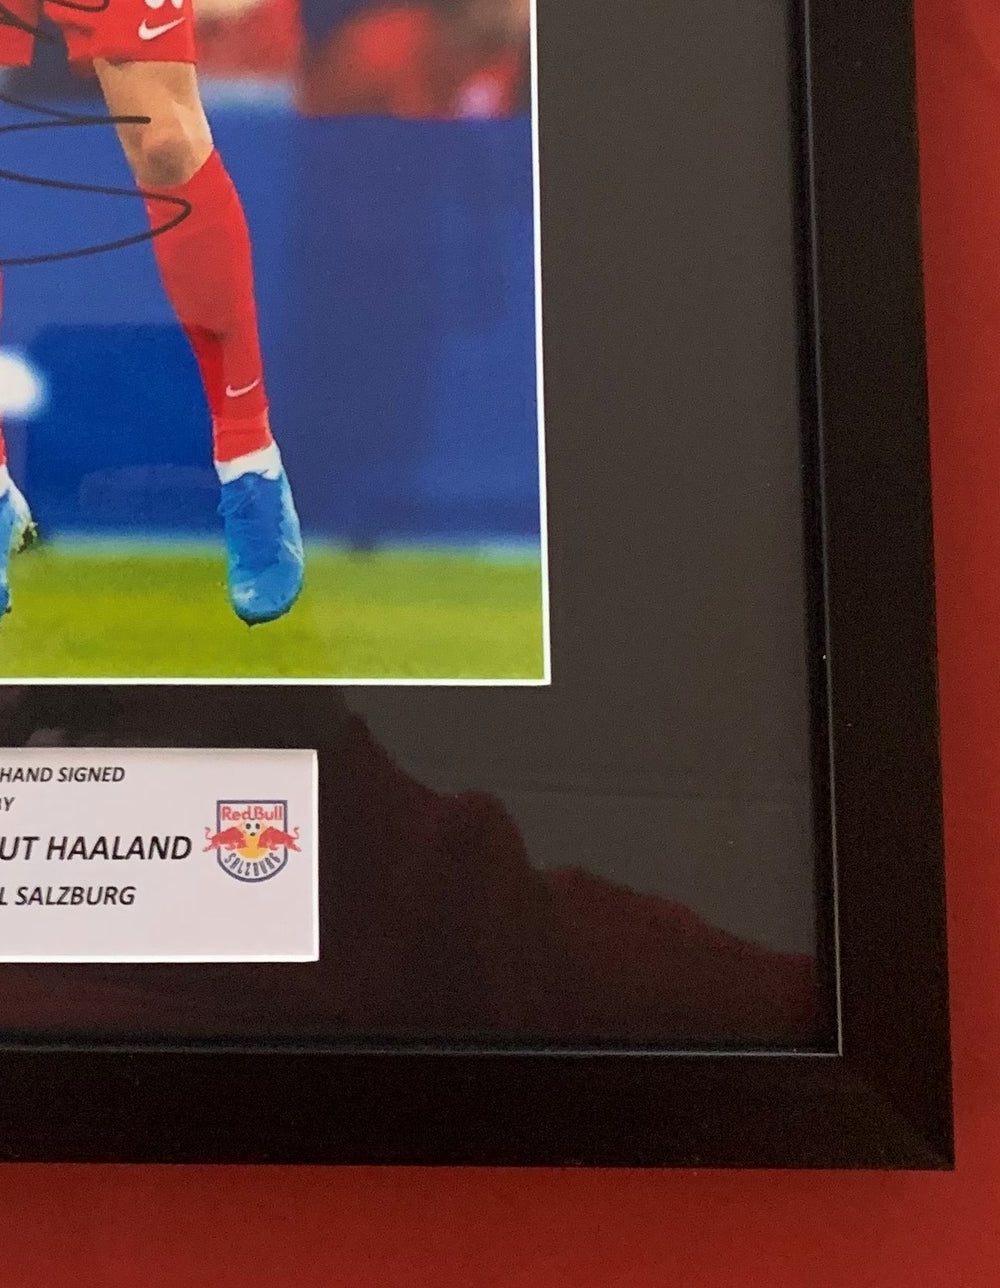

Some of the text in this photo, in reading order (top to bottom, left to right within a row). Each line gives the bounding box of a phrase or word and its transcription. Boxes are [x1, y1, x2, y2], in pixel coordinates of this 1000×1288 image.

[0, 767, 53, 783] HAND
[58, 767, 125, 783] SIGNED
[222, 806, 283, 821] Red Bull
[46, 835, 193, 861] HAALAND
[224, 852, 281, 876] SALZBURG
[14, 886, 137, 906] SALZBURG
